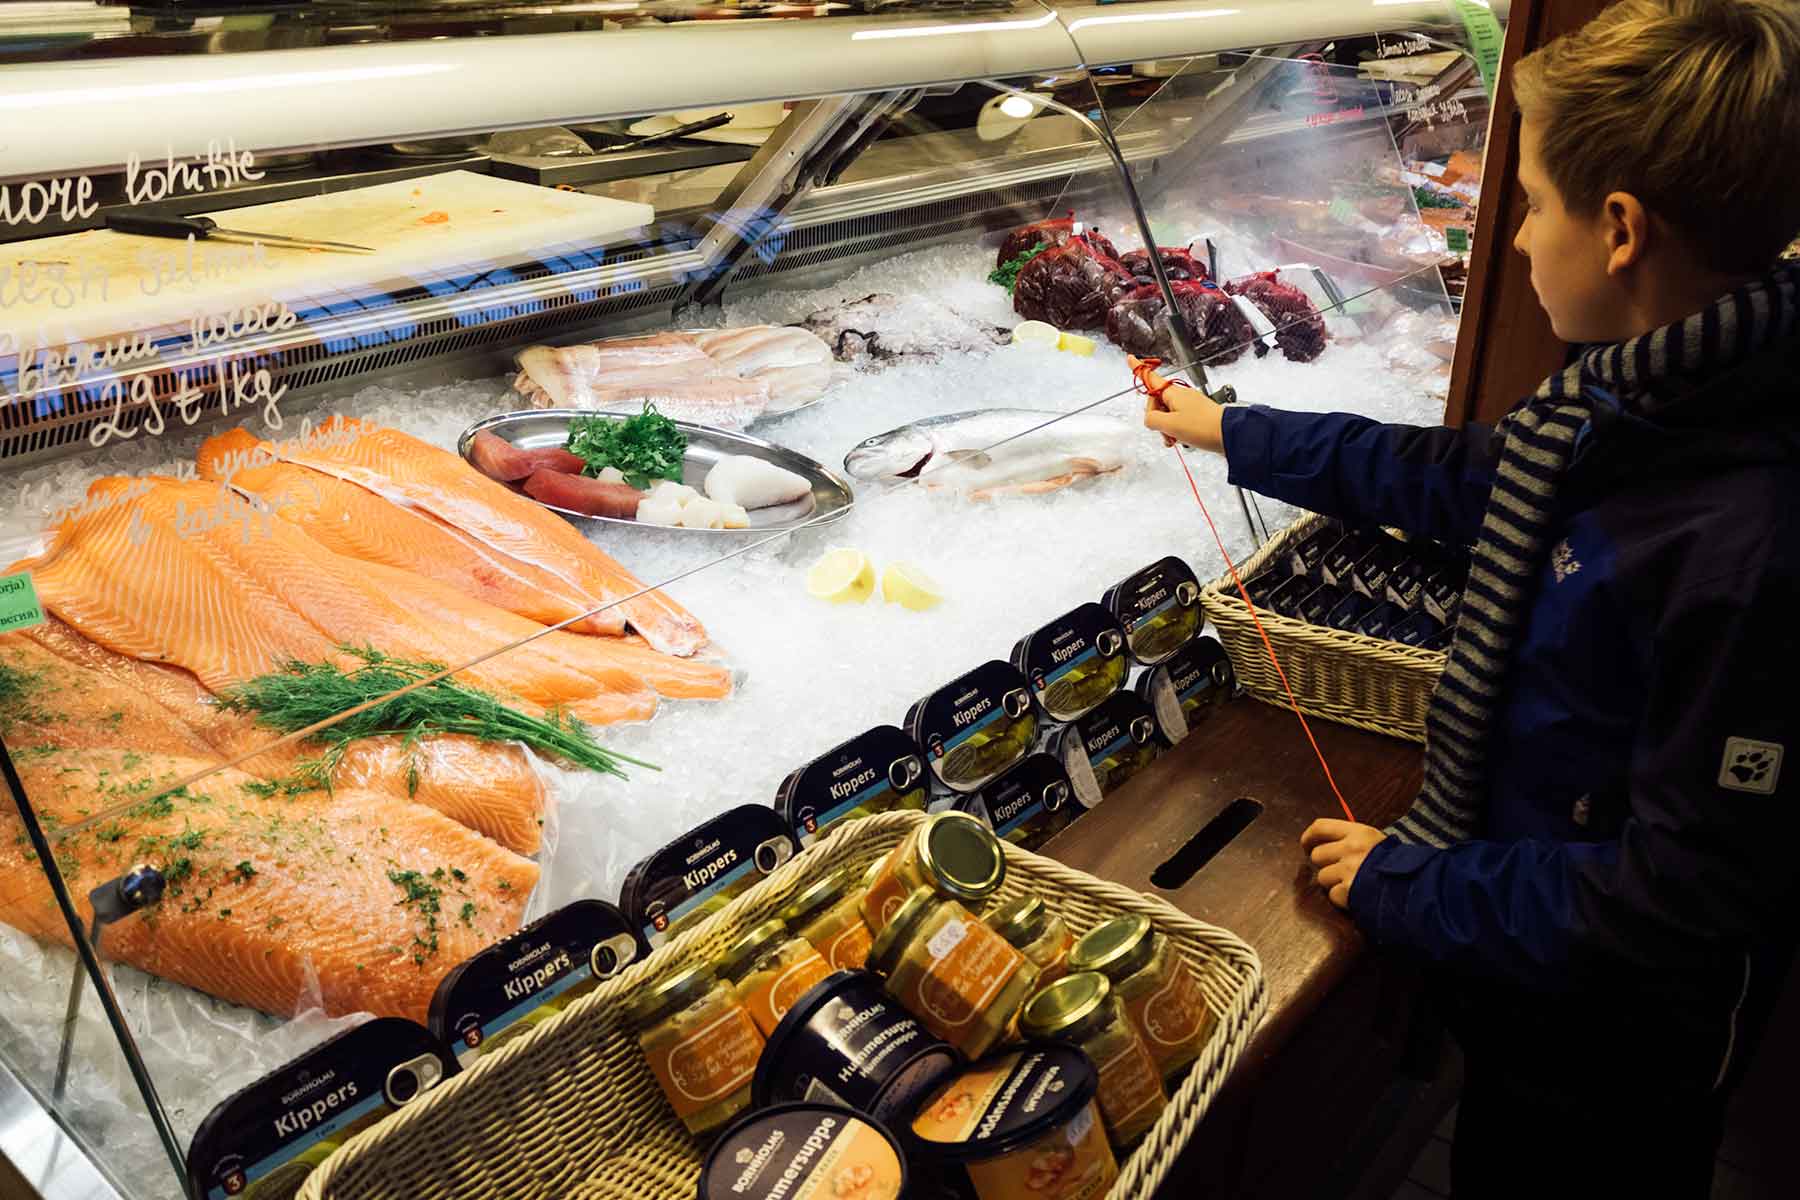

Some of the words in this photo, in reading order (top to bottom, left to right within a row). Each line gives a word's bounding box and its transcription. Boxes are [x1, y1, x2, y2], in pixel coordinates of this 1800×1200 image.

[1051, 637, 1086, 664] Kippers
[952, 697, 992, 728] Kippers
[829, 767, 877, 800] Kippers
[993, 791, 1032, 822] Kippers
[682, 849, 738, 891] Kippers
[503, 951, 571, 1001] Kippers
[273, 1080, 358, 1140] Kippers
[731, 1129, 785, 1193] BORNHOLMS
